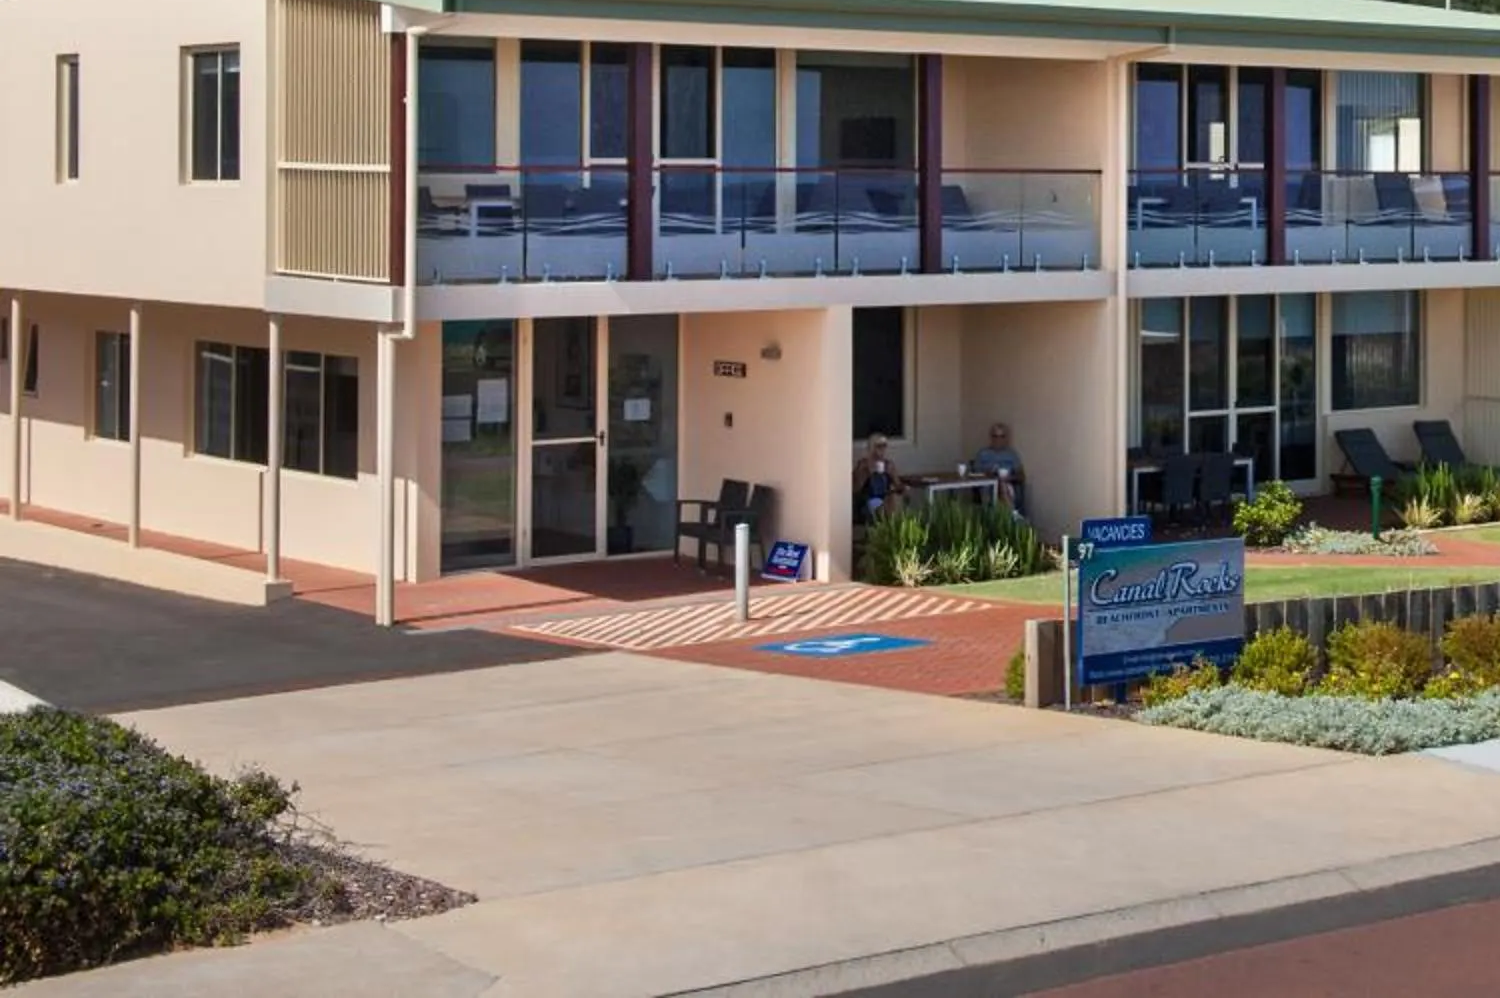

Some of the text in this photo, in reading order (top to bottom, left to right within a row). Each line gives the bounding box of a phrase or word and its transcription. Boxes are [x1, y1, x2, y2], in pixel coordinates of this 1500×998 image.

[1087, 523, 1145, 542] VACANCIES
[1078, 543, 1095, 559] 97
[1090, 560, 1240, 606] Canal Rocks
